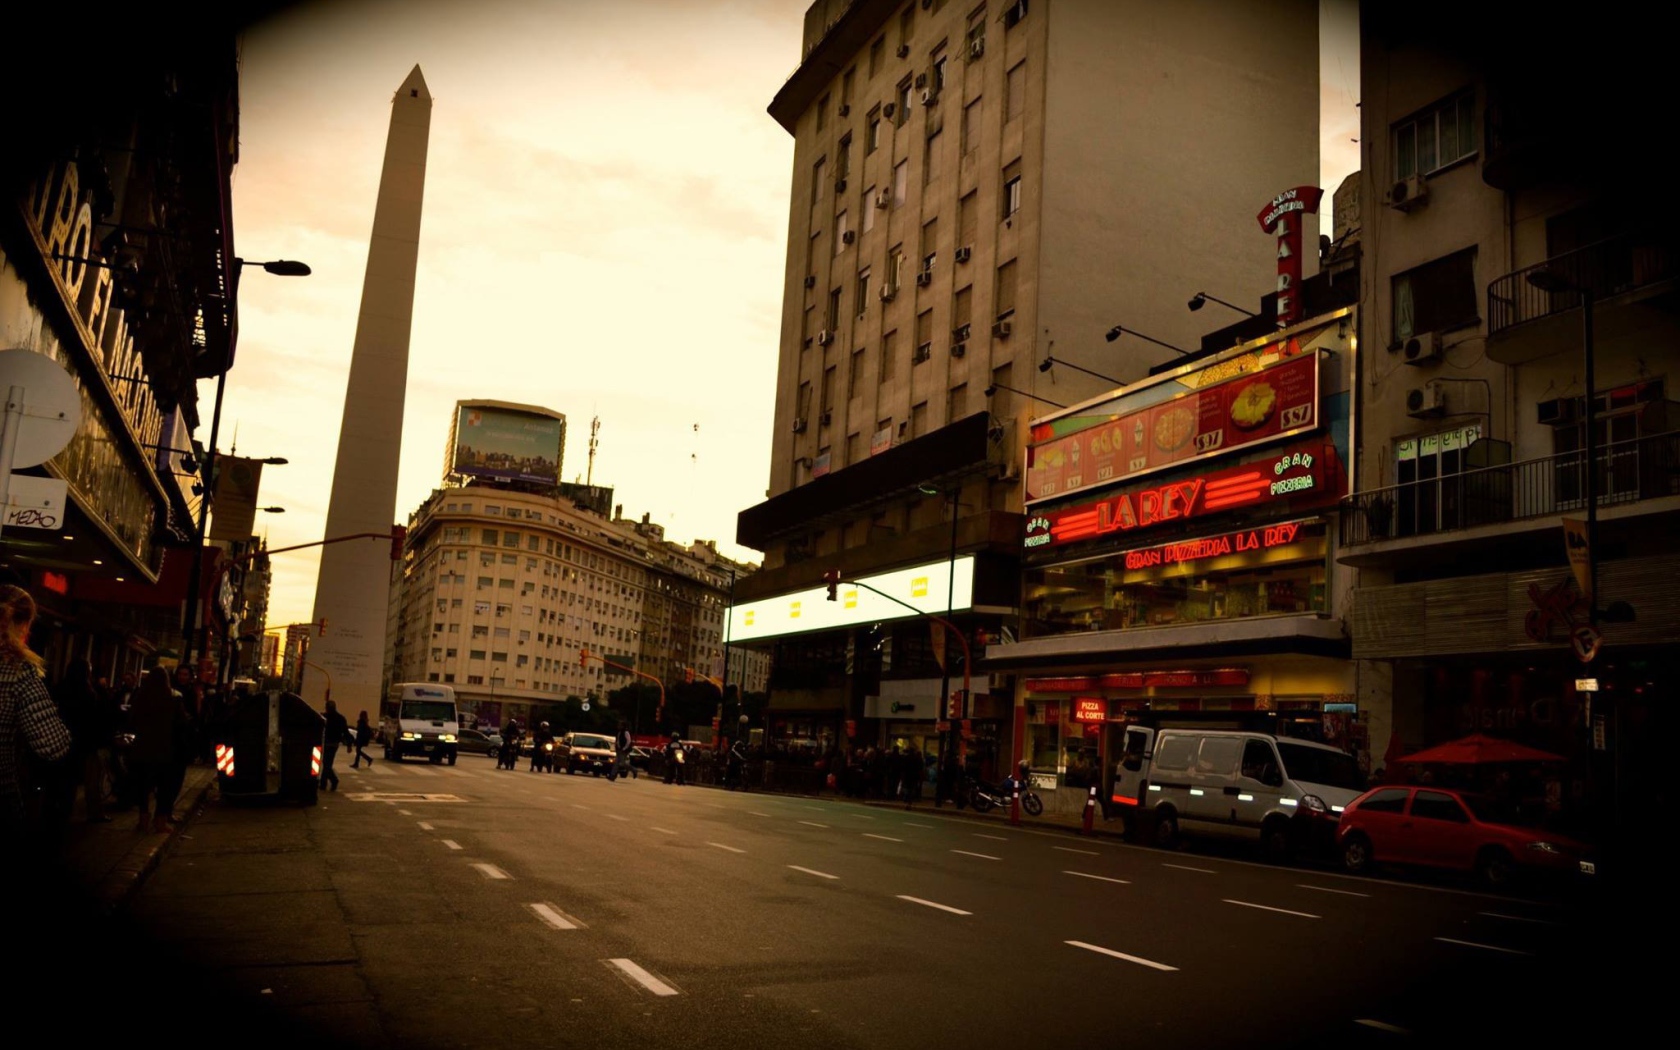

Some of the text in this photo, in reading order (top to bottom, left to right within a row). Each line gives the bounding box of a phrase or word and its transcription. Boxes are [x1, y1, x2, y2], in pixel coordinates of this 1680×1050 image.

[1273, 452, 1313, 476] GRAN
[1270, 474, 1314, 496] PIZZERIA
[1096, 478, 1203, 534] LA REY
[1026, 516, 1051, 534] GRAN
[1125, 523, 1299, 570] GRAN PIZZERIA LA REY
[1075, 711, 1105, 720] AL CORTE
[1081, 701, 1099, 711] PIZZA
